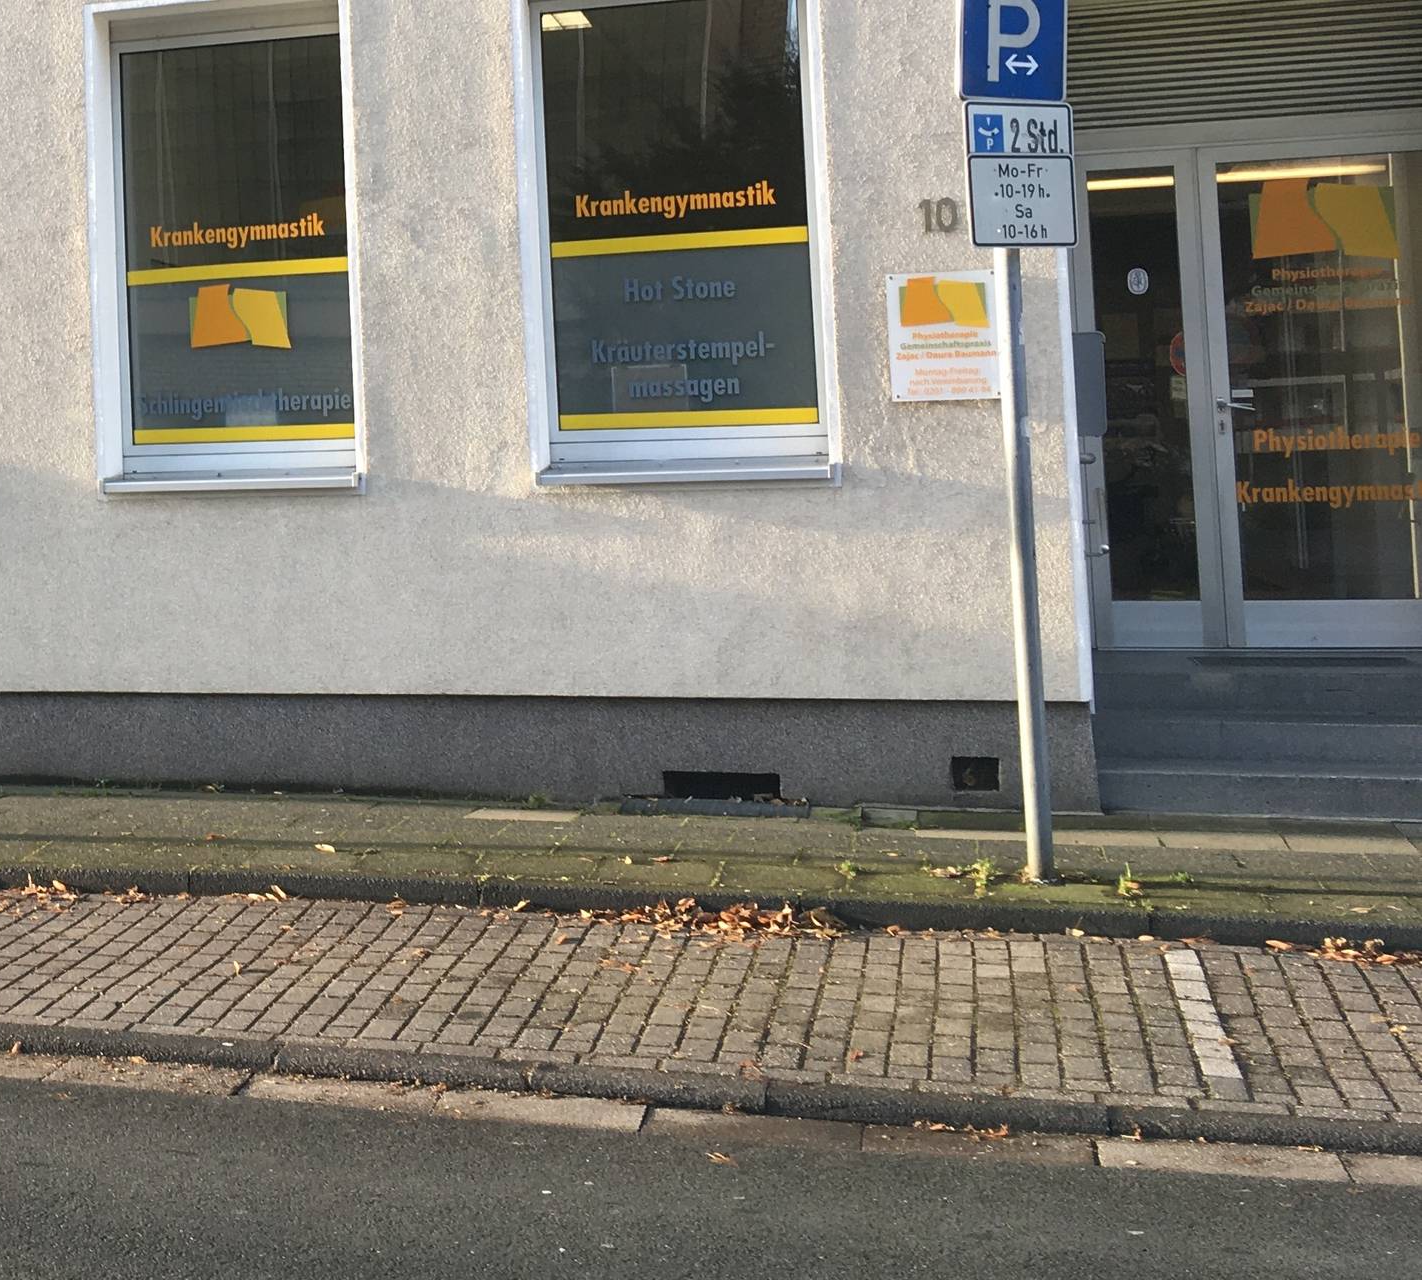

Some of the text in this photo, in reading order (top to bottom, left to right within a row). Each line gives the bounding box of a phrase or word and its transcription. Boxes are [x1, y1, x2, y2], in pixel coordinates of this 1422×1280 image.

[987, 0, 1041, 82] P
[1010, 118, 1064, 153] 2 Std.
[998, 163, 1043, 178] Mo-Fr
[576, 180, 777, 219] Krankengymnastik
[918, 196, 958, 233] 10
[1015, 203, 1033, 219] Sa
[150, 213, 325, 249] Krankengymnastik
[1002, 224, 1038, 239] 10-16
[625, 276, 736, 302] Hot Stone
[591, 331, 775, 366] Kräuterstempel-
[628, 376, 741, 403] massagen
